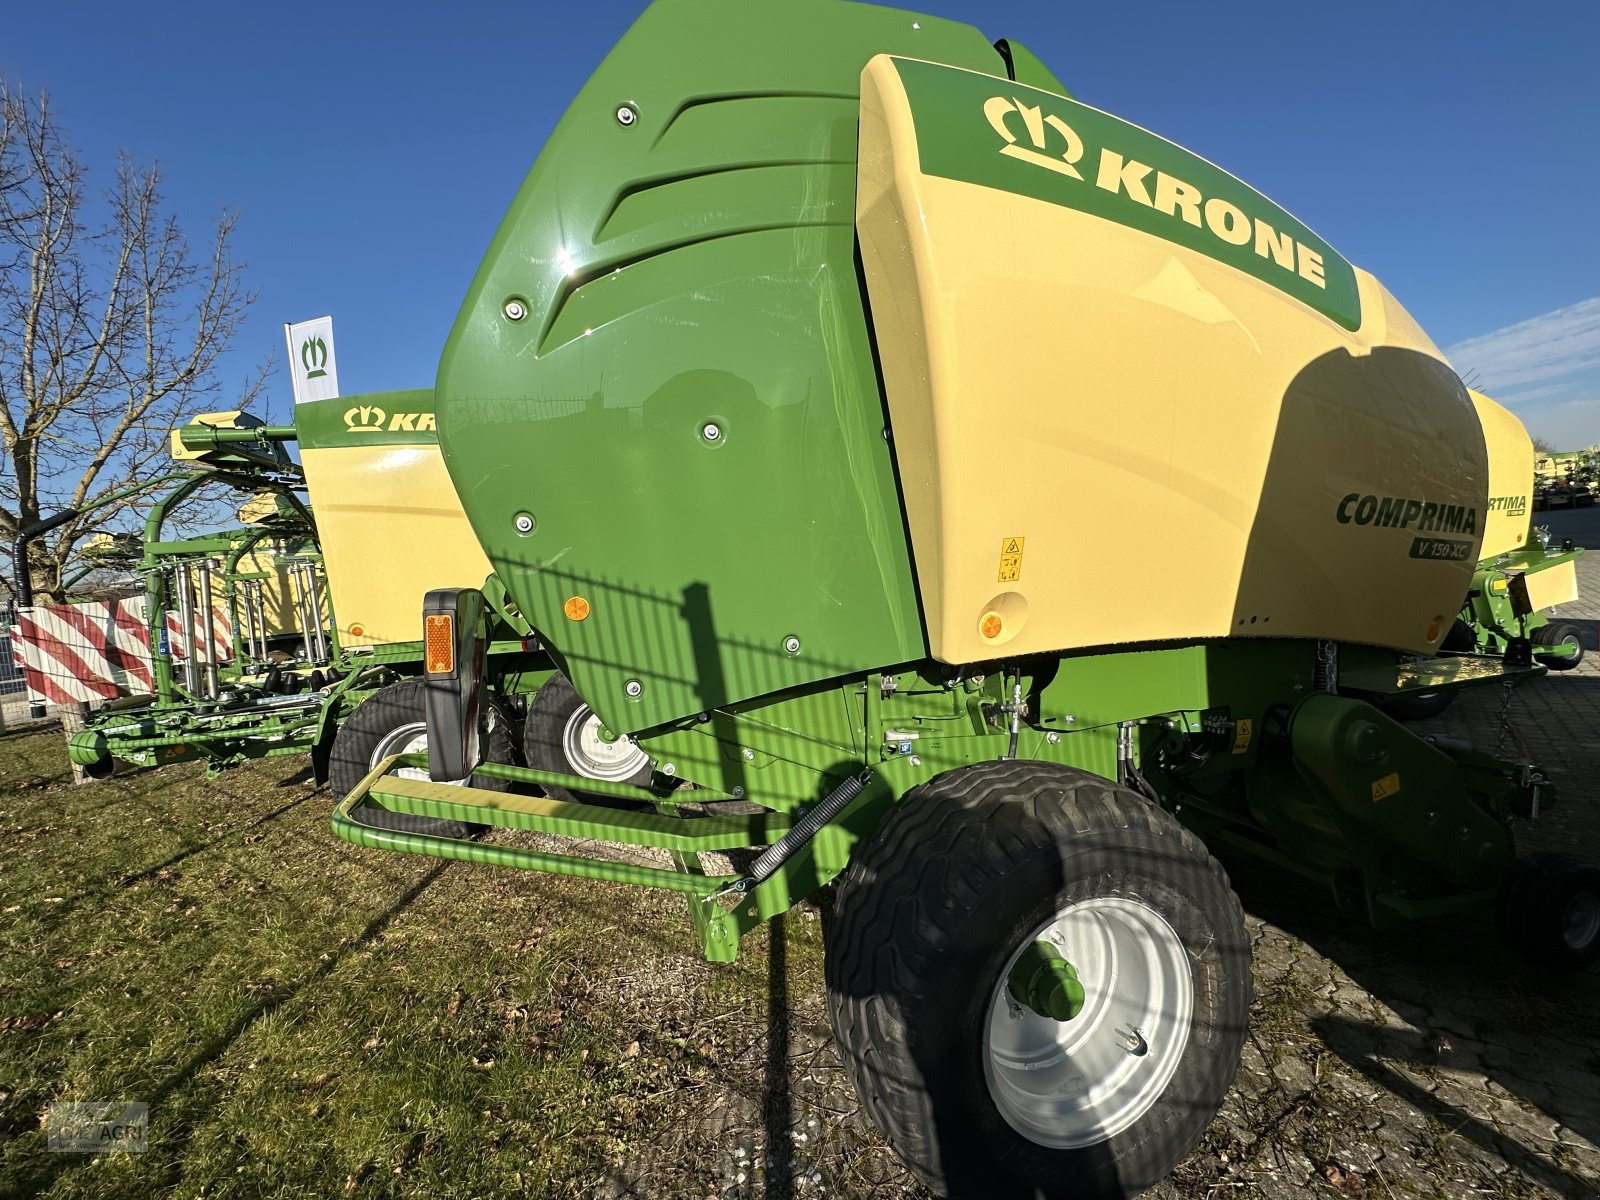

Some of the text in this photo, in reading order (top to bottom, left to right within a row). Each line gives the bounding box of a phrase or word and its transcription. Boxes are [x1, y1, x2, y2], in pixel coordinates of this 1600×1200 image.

[1096, 147, 1326, 290] KRONE
[1336, 493, 1476, 535] COMPRIMA
[1418, 541, 1468, 558] V 150 XC
